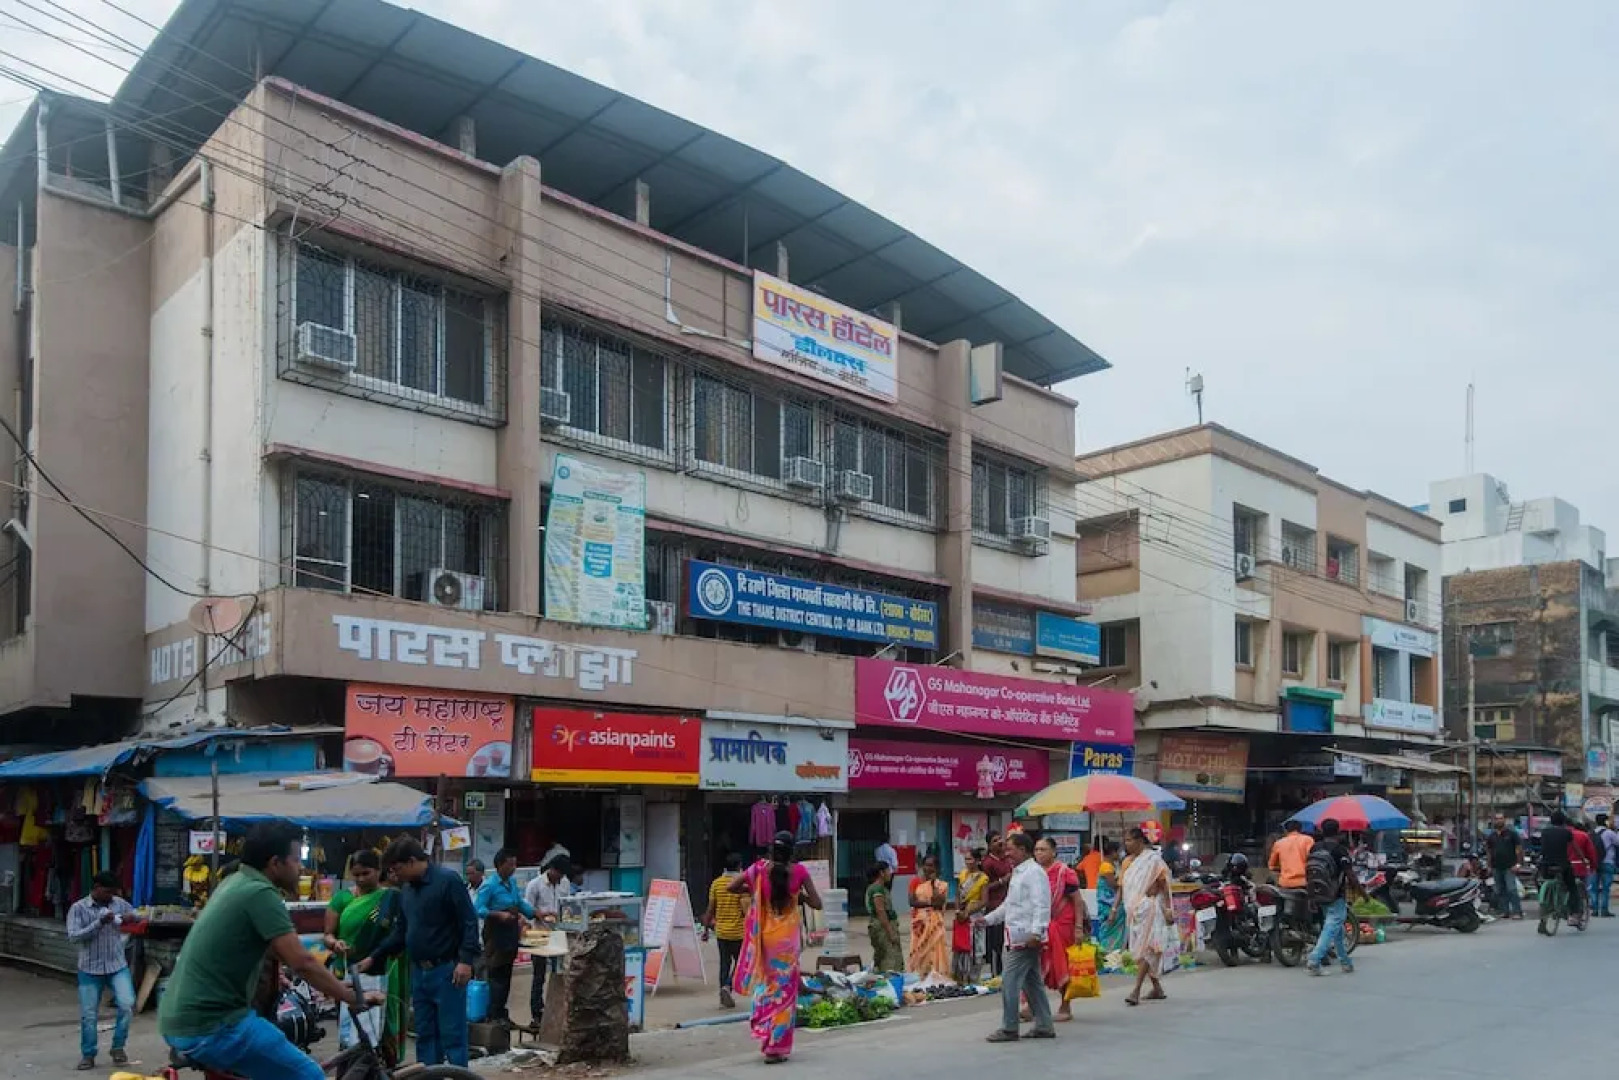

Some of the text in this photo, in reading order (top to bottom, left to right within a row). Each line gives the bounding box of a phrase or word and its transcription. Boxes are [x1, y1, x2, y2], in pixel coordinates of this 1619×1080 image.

[759, 287, 890, 355] पारस हॉटेल
[332, 615, 639, 691] पारस प्लाझा
[928, 677, 943, 691] GS
[944, 680, 1000, 699] Mahanagar
[1001, 686, 1055, 704] Co-operative
[1056, 692, 1077, 706] Bank
[356, 693, 506, 729] जय महाराष्ट्र
[393, 726, 470, 752] टी सेंटर
[589, 727, 676, 755] asianpaints
[709, 729, 788, 765] प्रामाणिक
[1083, 747, 1123, 767] Paras
